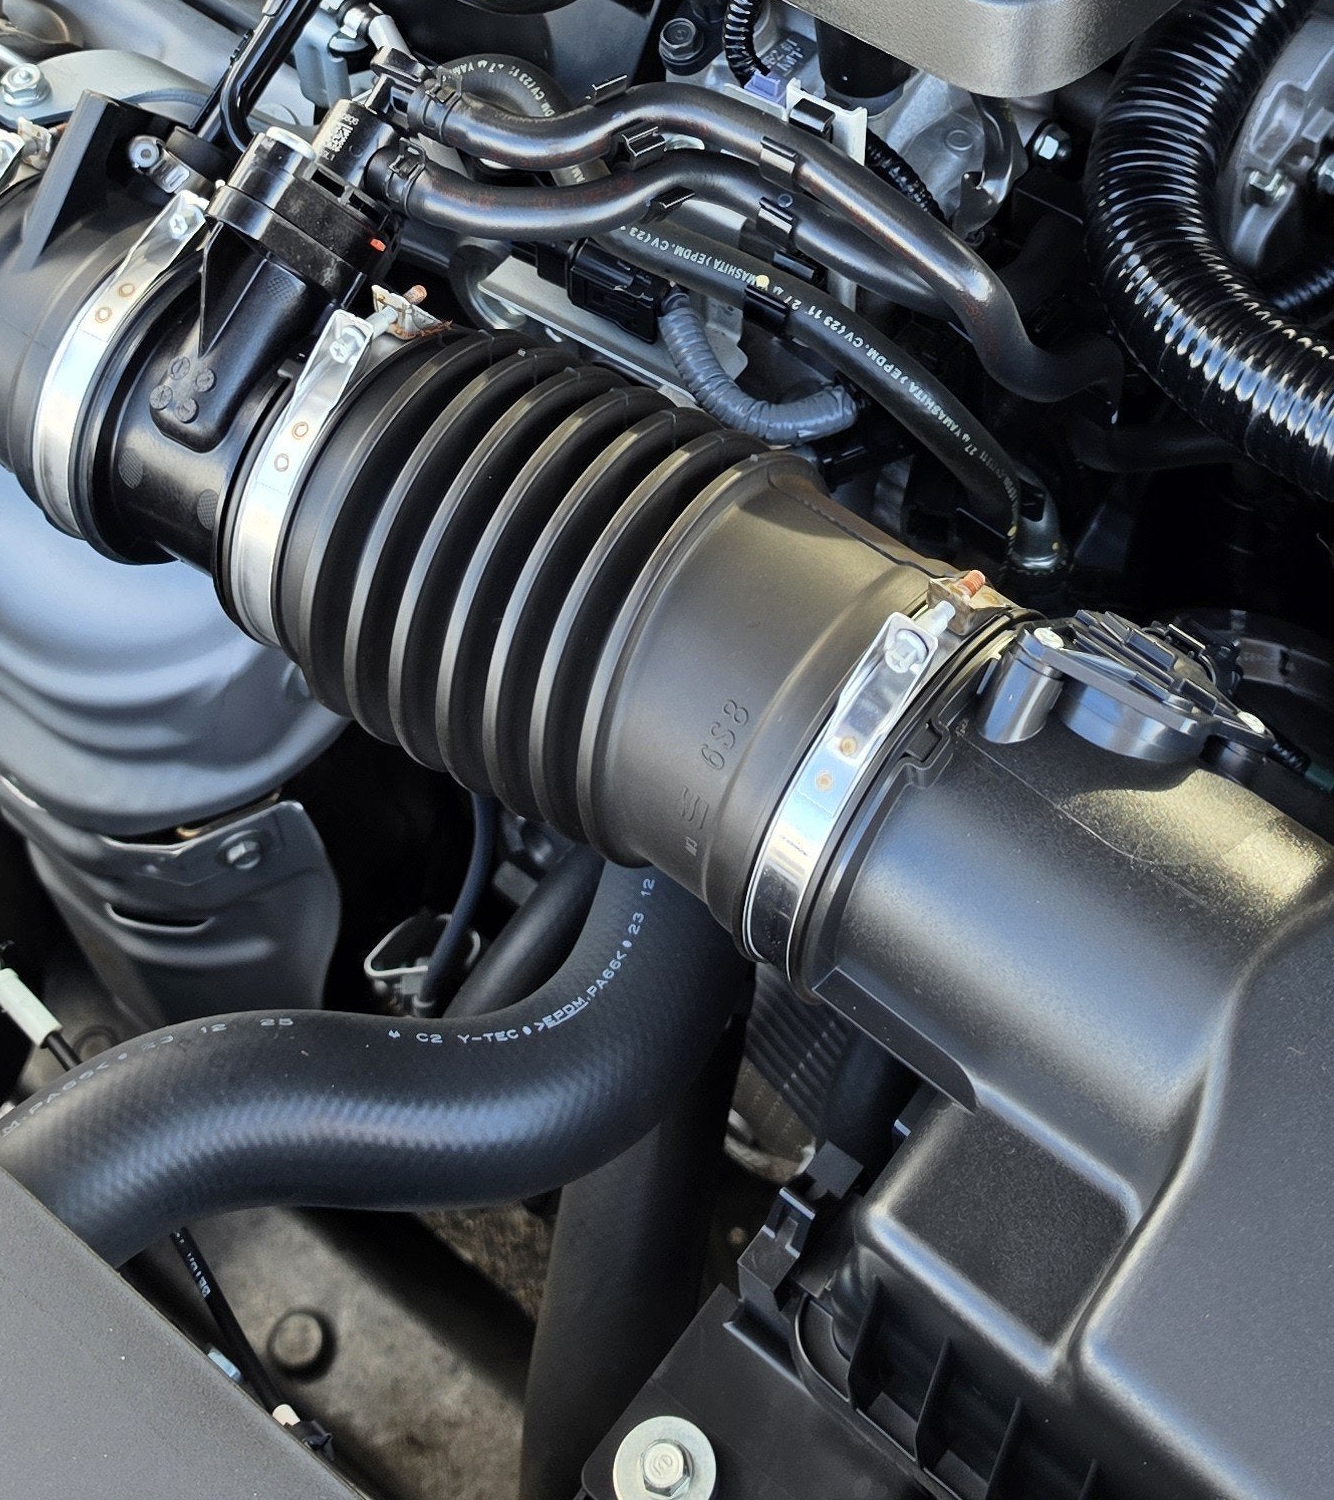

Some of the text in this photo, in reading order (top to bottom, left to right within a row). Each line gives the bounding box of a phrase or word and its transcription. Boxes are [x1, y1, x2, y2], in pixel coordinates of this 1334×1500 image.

[713, 257, 769, 292] MASHITA
[908, 381, 962, 438] YAMASHITA
[416, 1032, 443, 1044] C2
[457, 1028, 519, 1045] Y-TEC
[627, 911, 646, 936] 23
[641, 877, 656, 897] 12
